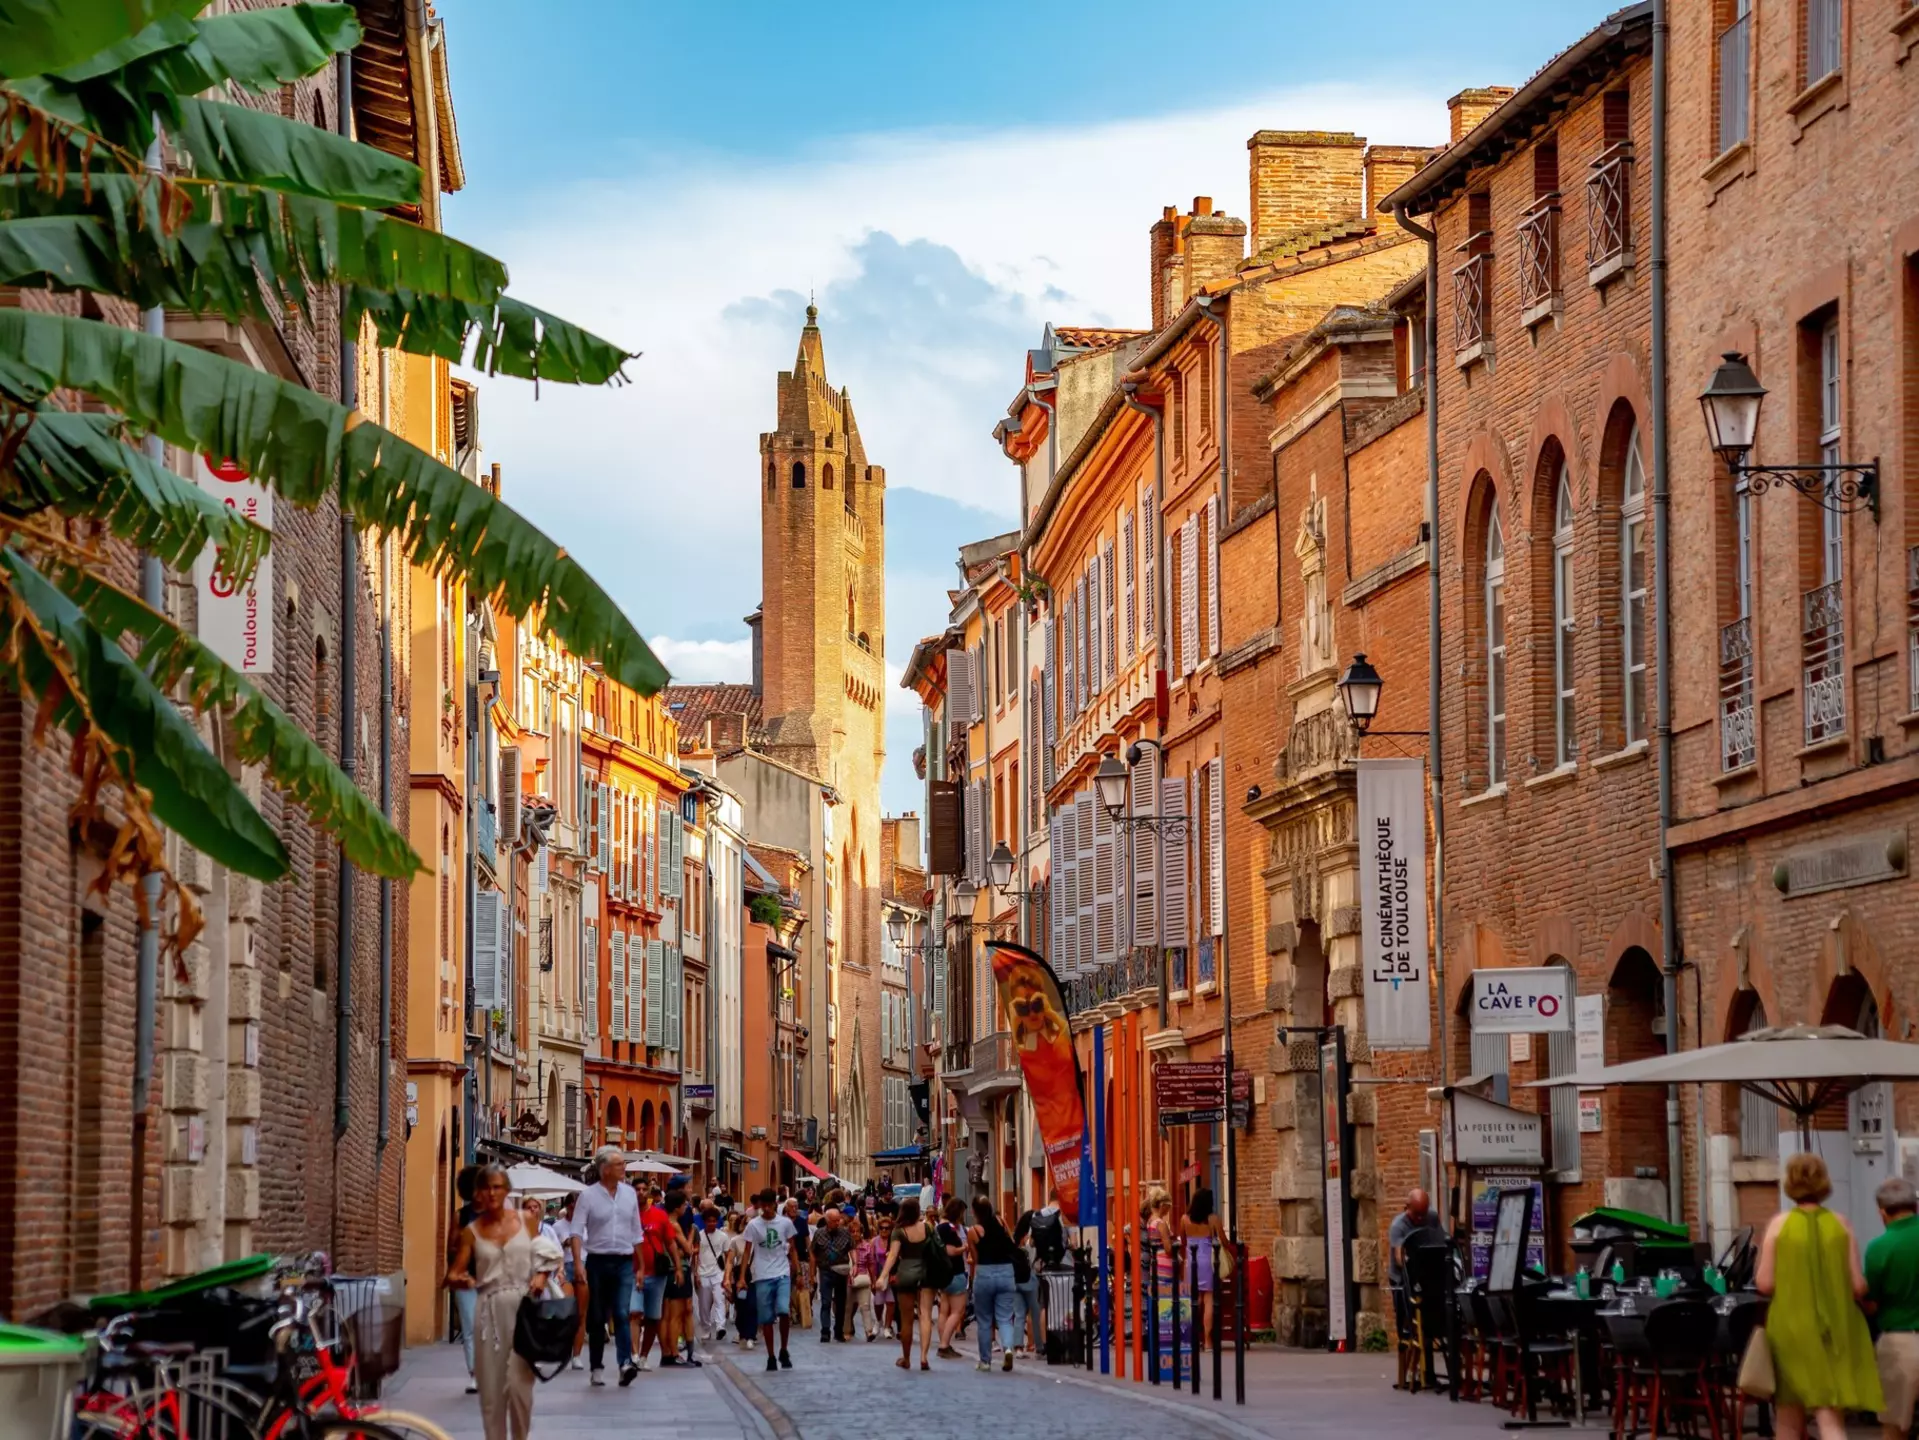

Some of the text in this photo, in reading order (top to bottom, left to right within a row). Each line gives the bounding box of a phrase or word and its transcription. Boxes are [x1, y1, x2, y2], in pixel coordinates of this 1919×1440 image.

[242, 589, 257, 669] Toulouse
[1375, 816, 1394, 974] LA CINÉMATHÈQUE
[1394, 857, 1410, 973] DE TOULOUSE
[1488, 982, 1508, 996] LA
[1478, 995, 1523, 1010] CAVE
[1458, 1124, 1469, 1132] LA
[1505, 1123, 1515, 1131] EN
[1482, 1135, 1492, 1143] DE
[1487, 1178, 1529, 1186] MUSIQUE
